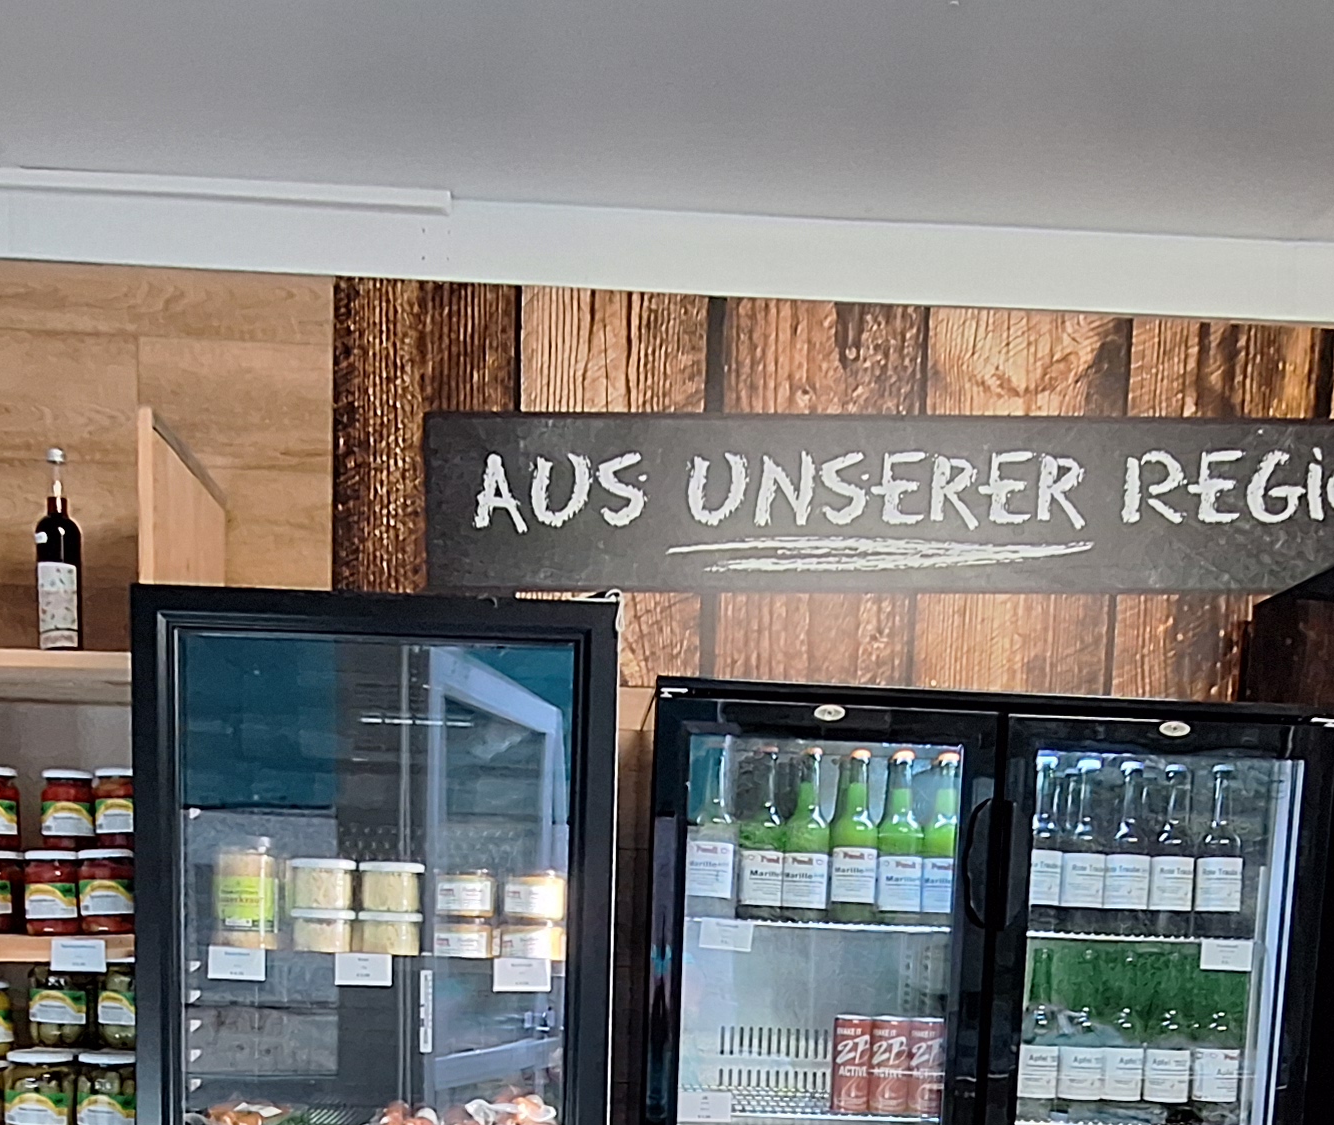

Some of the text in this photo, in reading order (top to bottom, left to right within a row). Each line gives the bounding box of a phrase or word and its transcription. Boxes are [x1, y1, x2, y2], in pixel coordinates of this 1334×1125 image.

[471, 450, 647, 533] AUS
[685, 449, 1088, 531] UNSERER
[871, 1036, 908, 1065] 2B
[839, 1066, 867, 1077] ACTIVE
